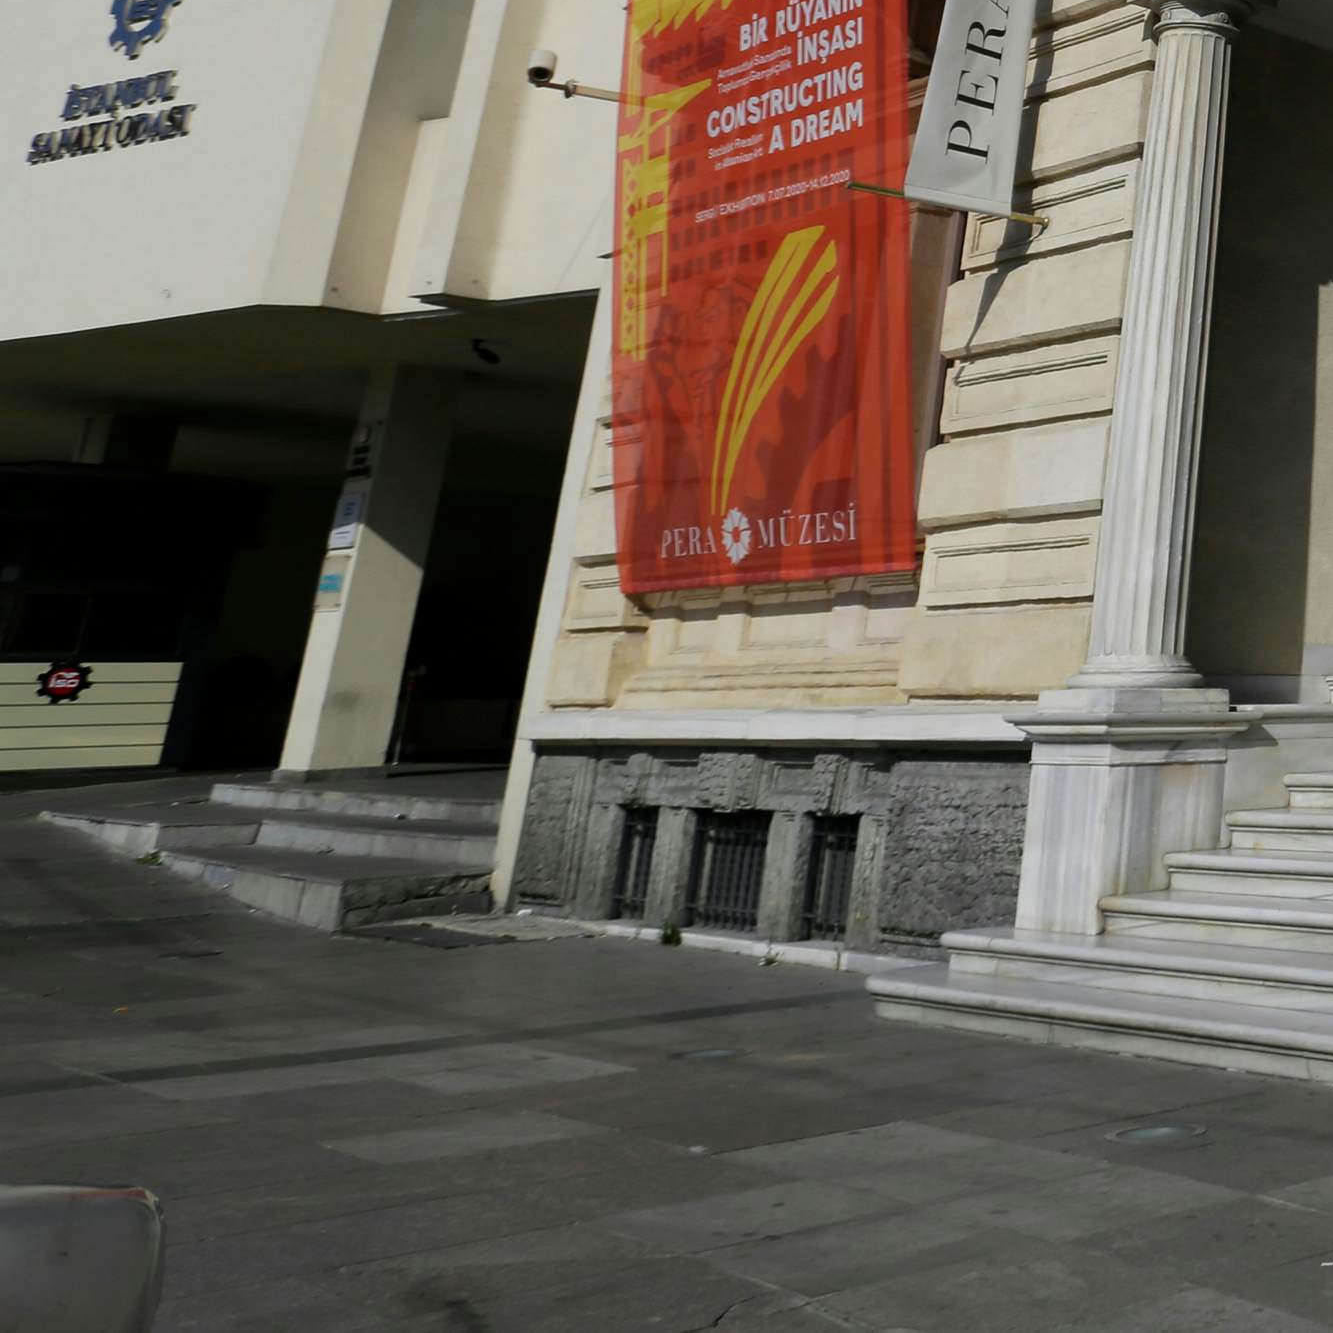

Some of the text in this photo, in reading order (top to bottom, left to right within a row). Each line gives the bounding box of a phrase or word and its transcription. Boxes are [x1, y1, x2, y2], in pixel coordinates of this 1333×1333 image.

[739, 13, 768, 51] BİR
[797, 17, 864, 65] İNŞASI
[706, 62, 864, 137] CONSTRUCTING
[768, 125, 785, 154] A
[791, 99, 864, 148] DREAM
[660, 502, 857, 558] PERA MÜZESİ
